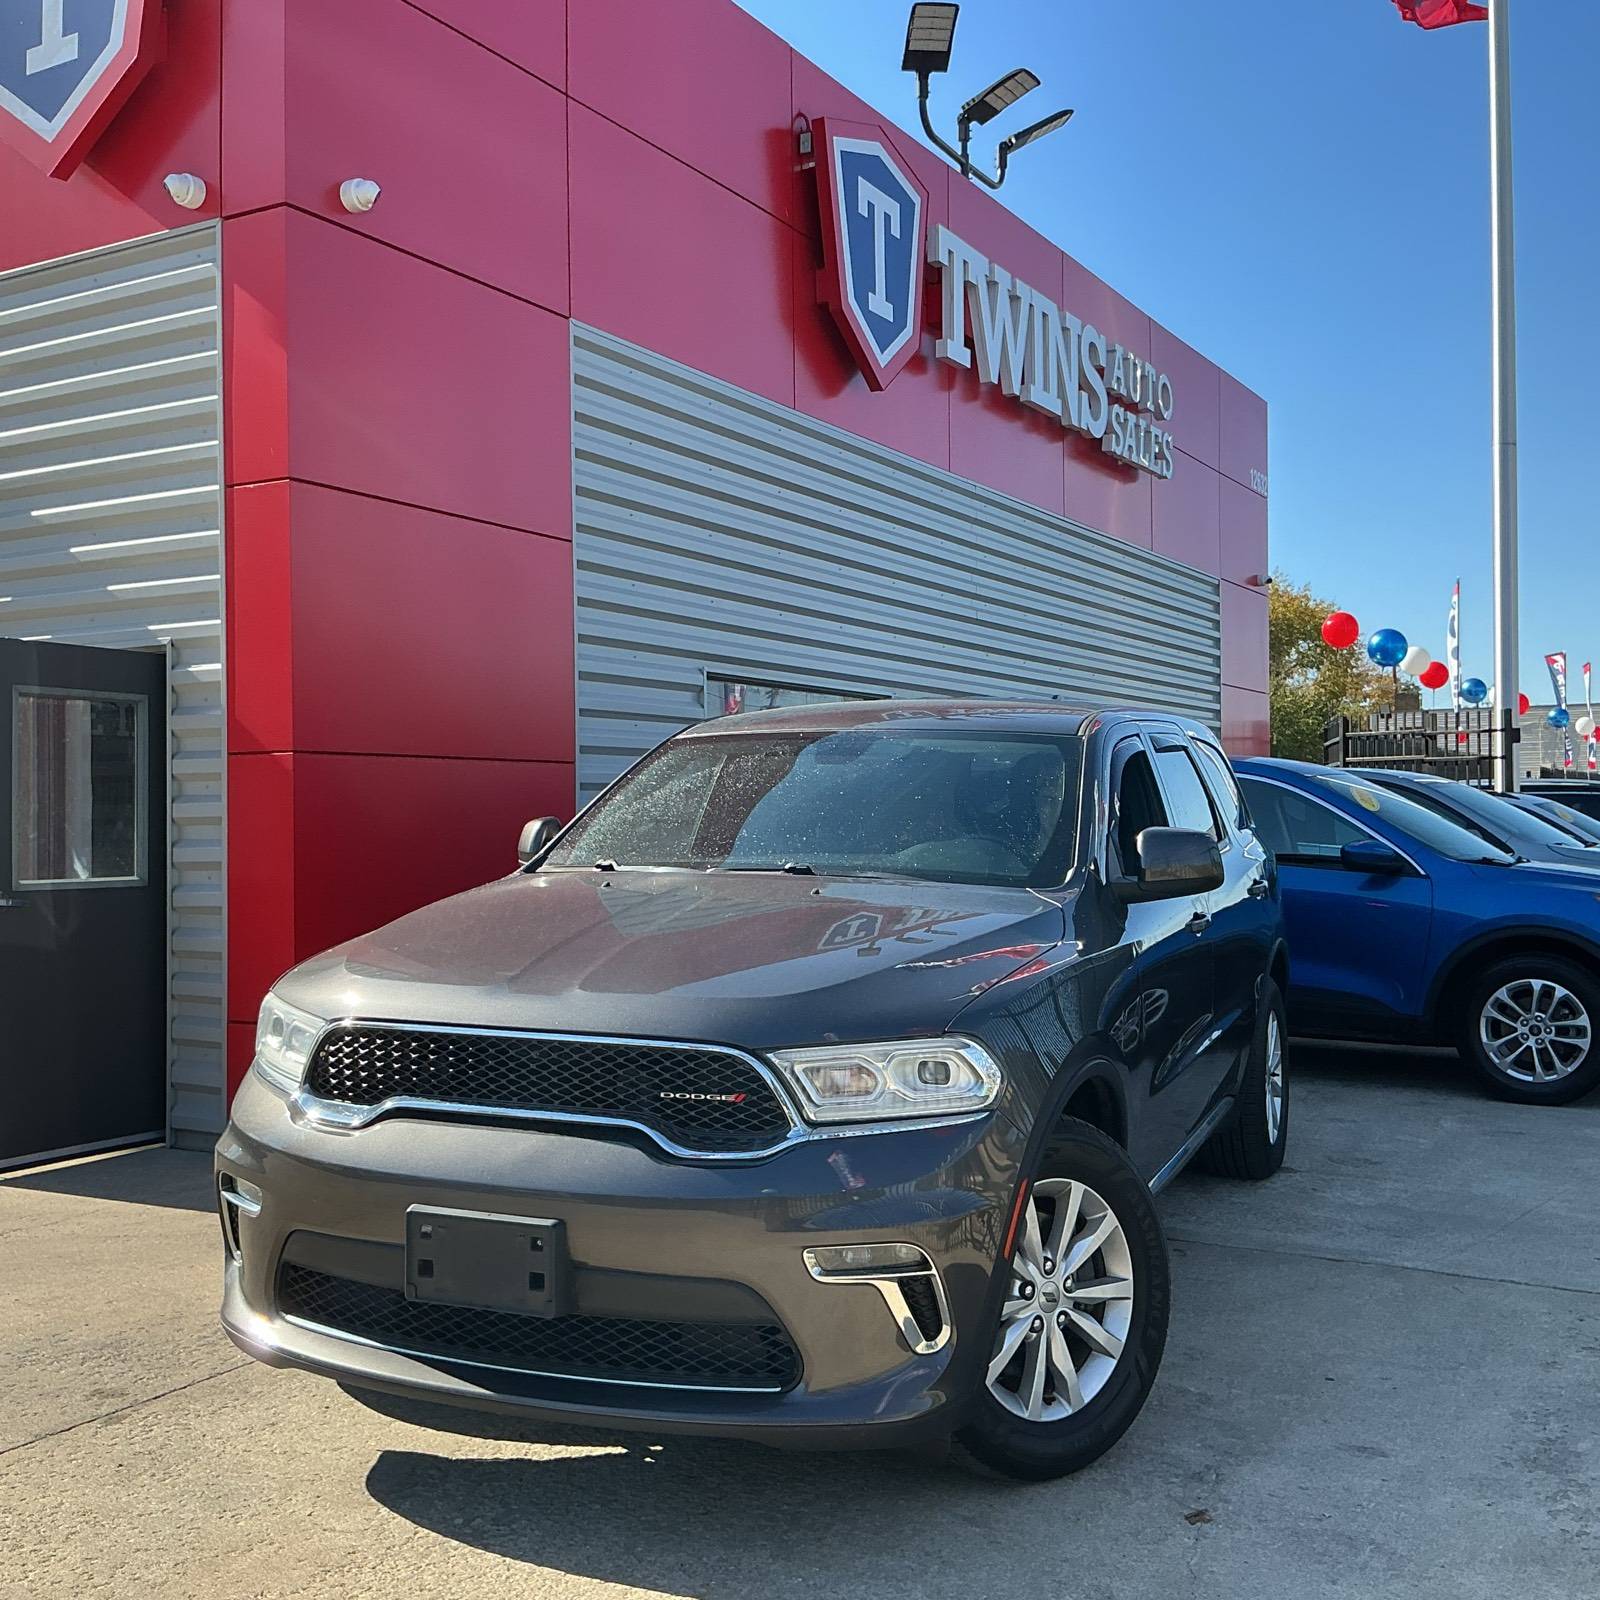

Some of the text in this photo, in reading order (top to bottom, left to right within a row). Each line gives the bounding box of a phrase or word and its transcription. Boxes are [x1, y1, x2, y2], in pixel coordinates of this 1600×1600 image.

[857, 175, 901, 324] T
[930, 224, 1108, 439] TWINS
[1109, 343, 1173, 421] AUTO
[1108, 403, 1174, 480] SALES
[660, 1091, 735, 1102] DODGE
